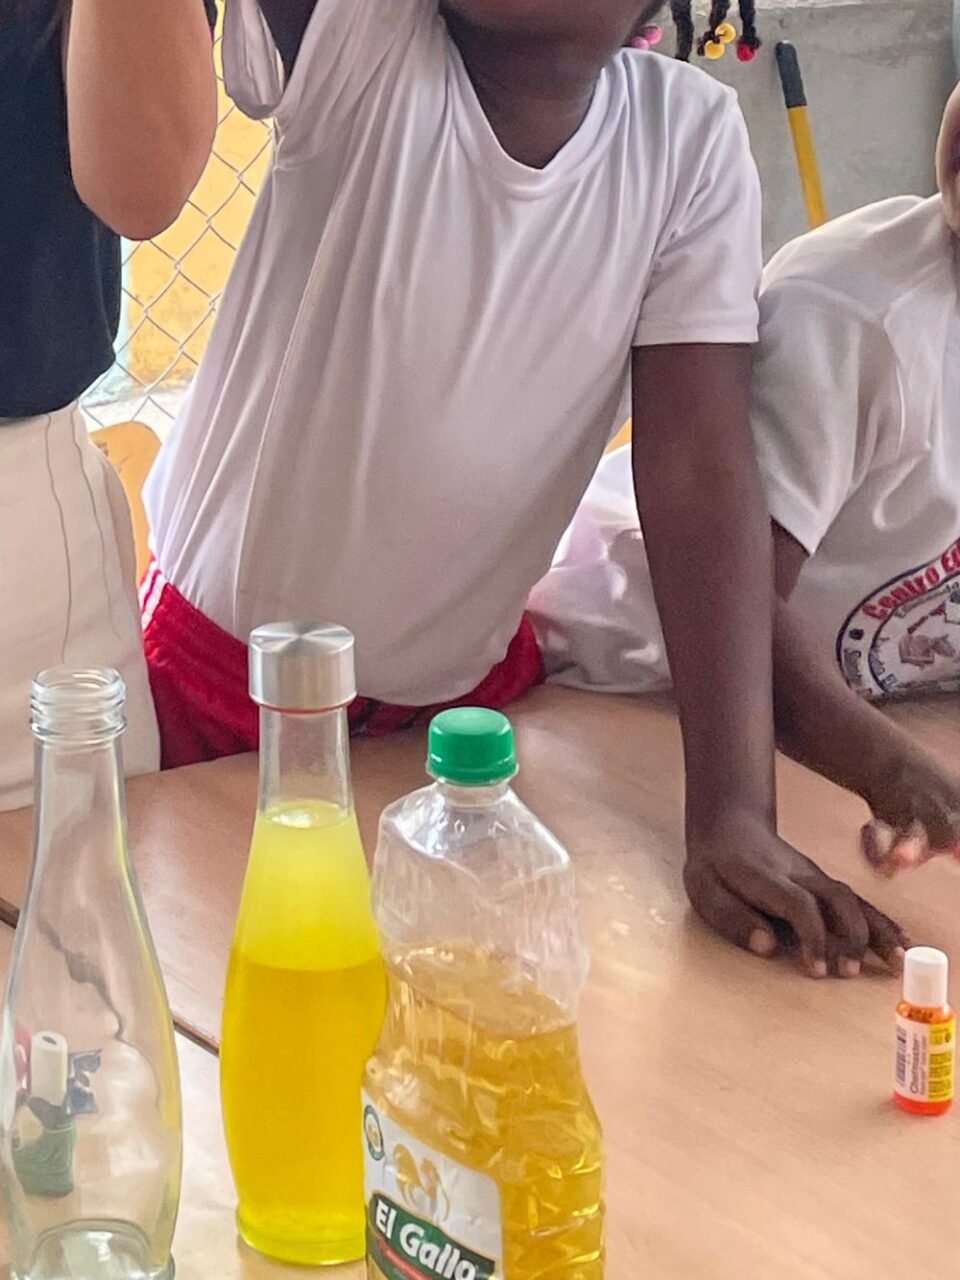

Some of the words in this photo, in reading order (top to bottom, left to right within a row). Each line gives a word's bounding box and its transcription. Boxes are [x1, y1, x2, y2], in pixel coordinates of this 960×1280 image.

[862, 566, 940, 620] Centro
[376, 1199, 397, 1239] El
[400, 1223, 476, 1280] Gallo
